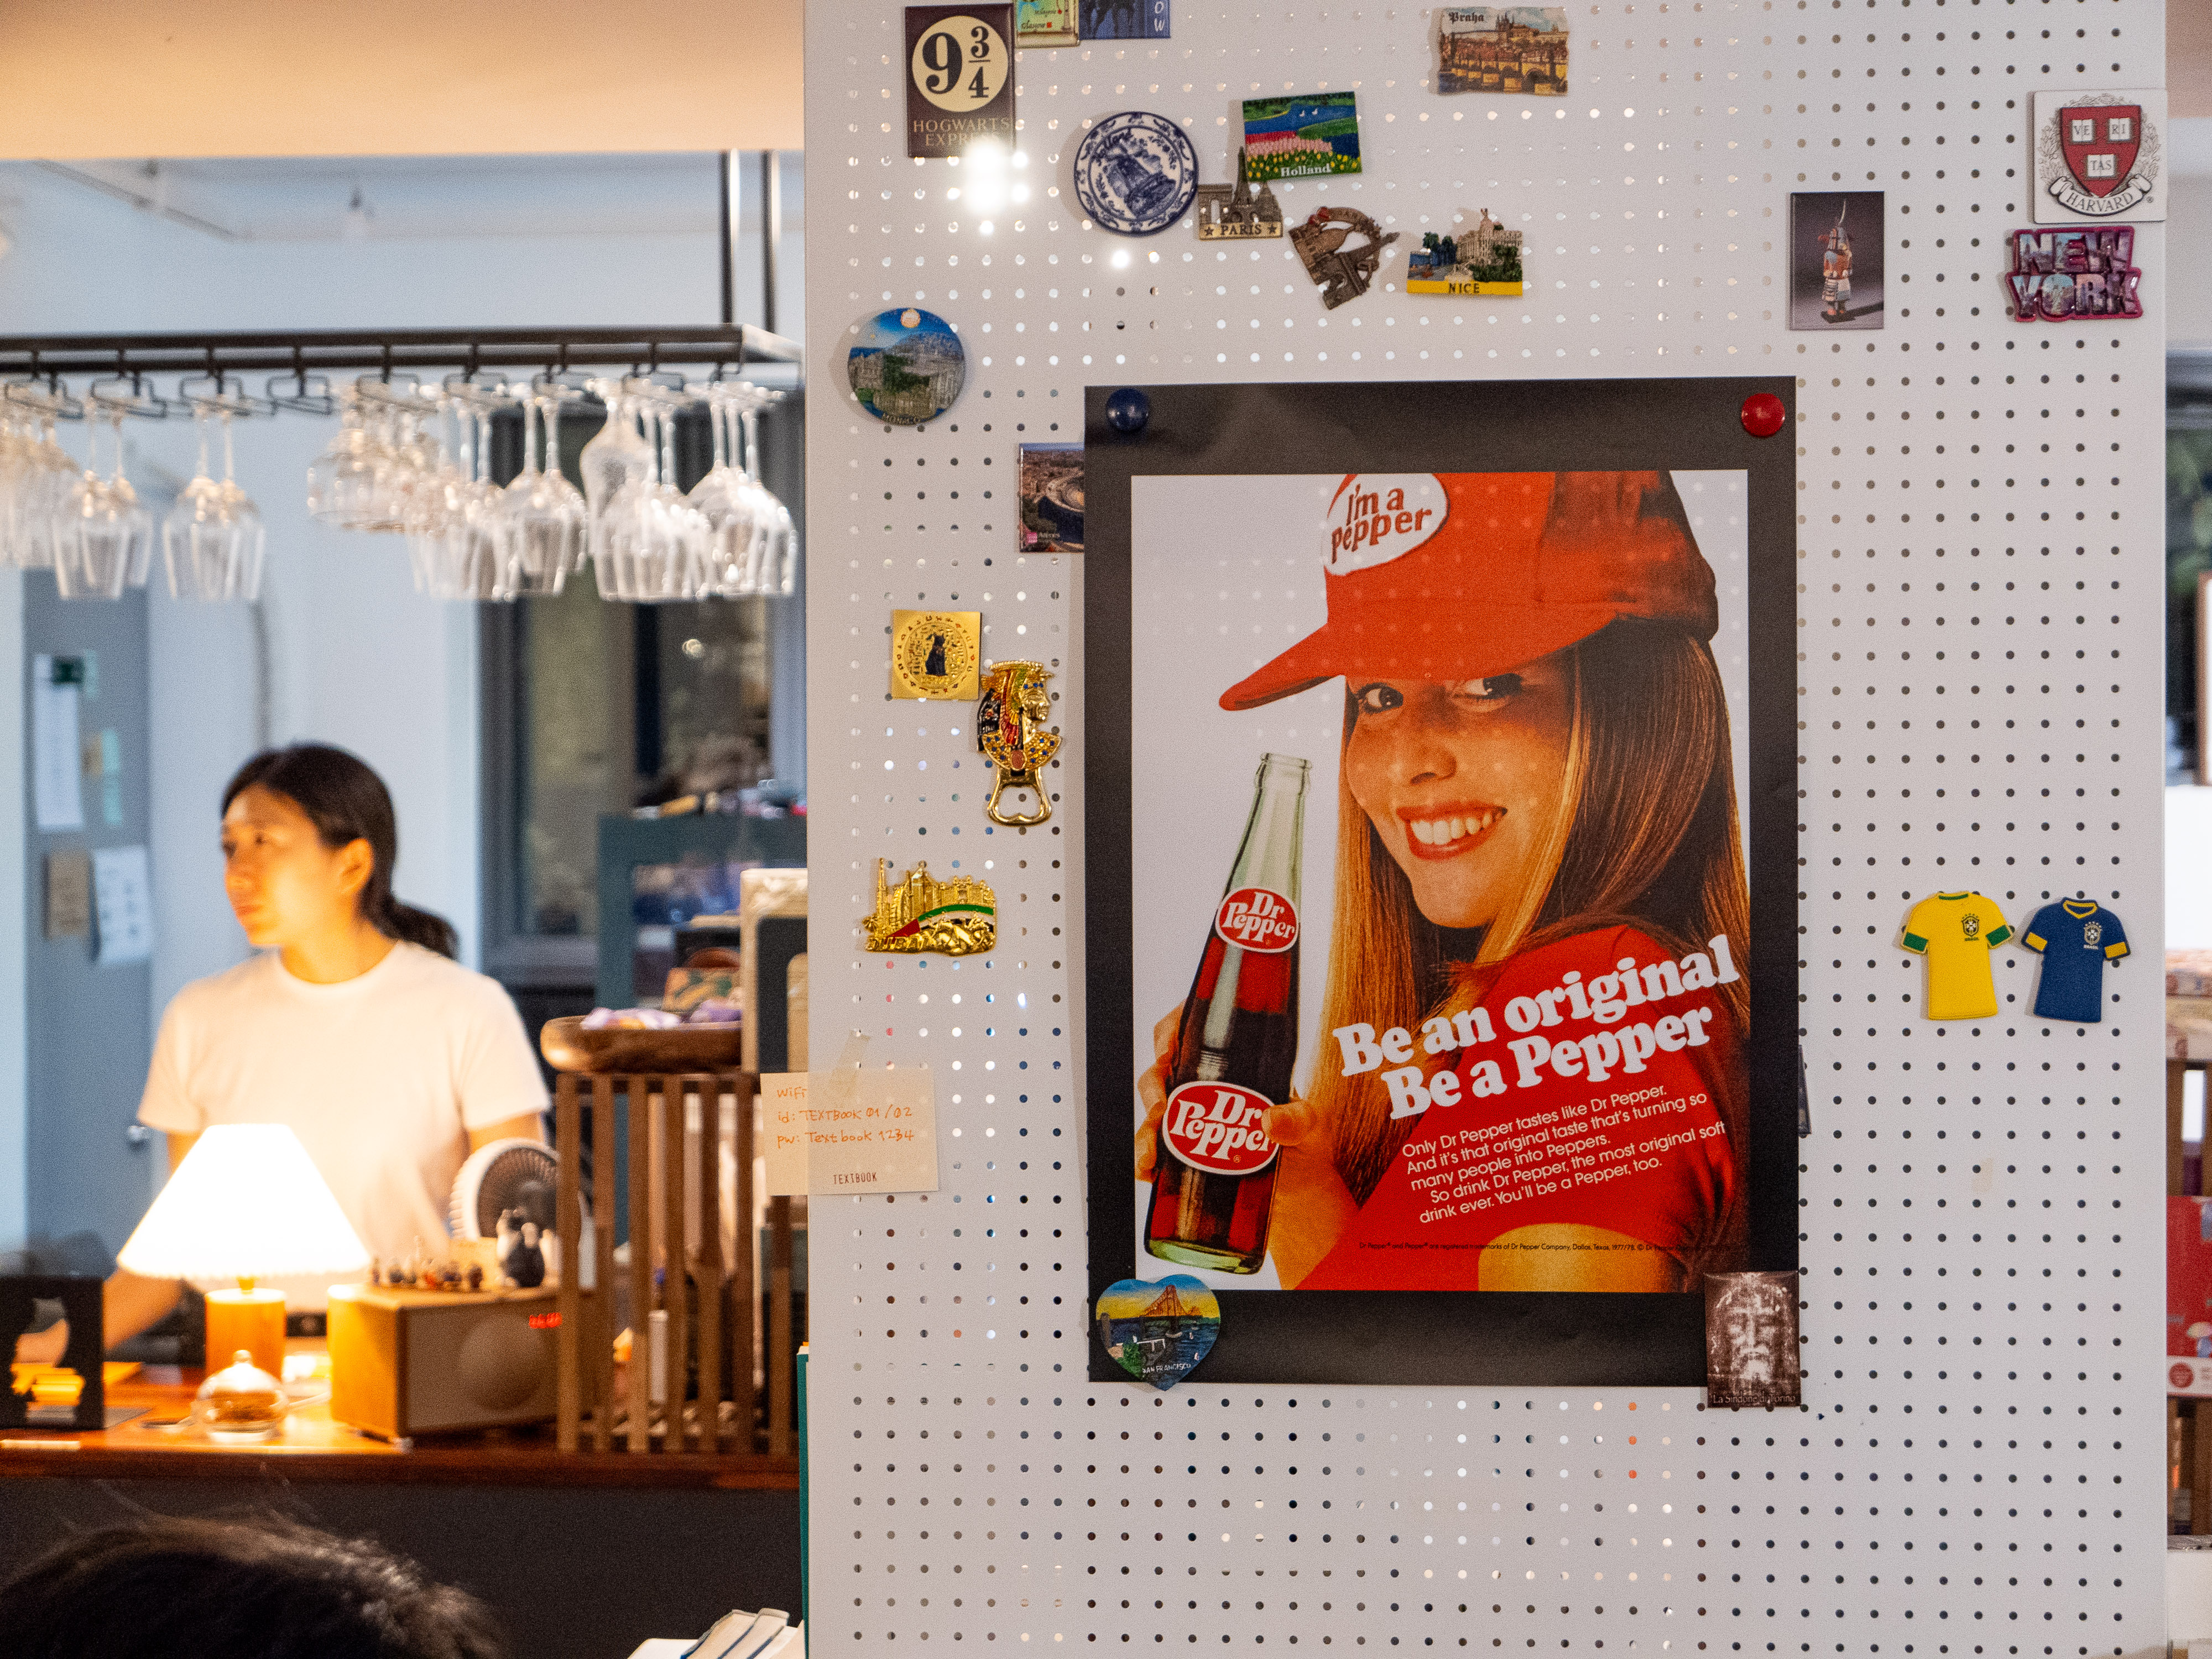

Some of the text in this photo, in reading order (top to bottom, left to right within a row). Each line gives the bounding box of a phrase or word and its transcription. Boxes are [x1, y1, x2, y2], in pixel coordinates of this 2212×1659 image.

[1448, 11, 1485, 24] Praha
[914, 117, 1011, 133] HOGWARTS
[2073, 124, 2126, 135] VE RI
[926, 132, 1000, 147] EXPR
[1280, 163, 1332, 178] Holland
[2090, 160, 2111, 171] TAS
[2066, 192, 2133, 212] HARVARD
[1220, 223, 1262, 236] PARIS
[2018, 231, 2130, 273] NEW
[1447, 282, 1480, 295] NICE
[2012, 273, 2138, 317] YORK
[1386, 488, 1405, 511] a
[1331, 507, 1432, 565] pepper
[1246, 891, 1285, 920] Dr
[1221, 902, 1296, 943] Pepper
[1332, 933, 1741, 1077] Be an original
[1380, 1006, 1713, 1120] Be a Pepper
[1202, 1089, 1262, 1128] Dr
[1402, 1086, 1667, 1157] Only Dr Pepper tastes like Dr Pepper.
[878, 1128, 915, 1142] 1234
[1407, 1093, 1707, 1174] And it's that original taste that's turning so
[1411, 1135, 1611, 1190] many people into Peppers.
[1431, 1121, 1725, 1203] So drink Dr Pepper, the most original soft
[833, 1171, 878, 1185] TEXTBOOK
[1420, 1158, 1662, 1223] drink ever. You'll be a Pepper, too.
[1541, 1243, 1571, 1251] Company,
[1156, 1363, 1191, 1373] FRANCISCO
[1713, 1395, 1723, 1404] La
[1725, 1391, 1757, 1404] Sindone
[1770, 1393, 1796, 1403] Torino
